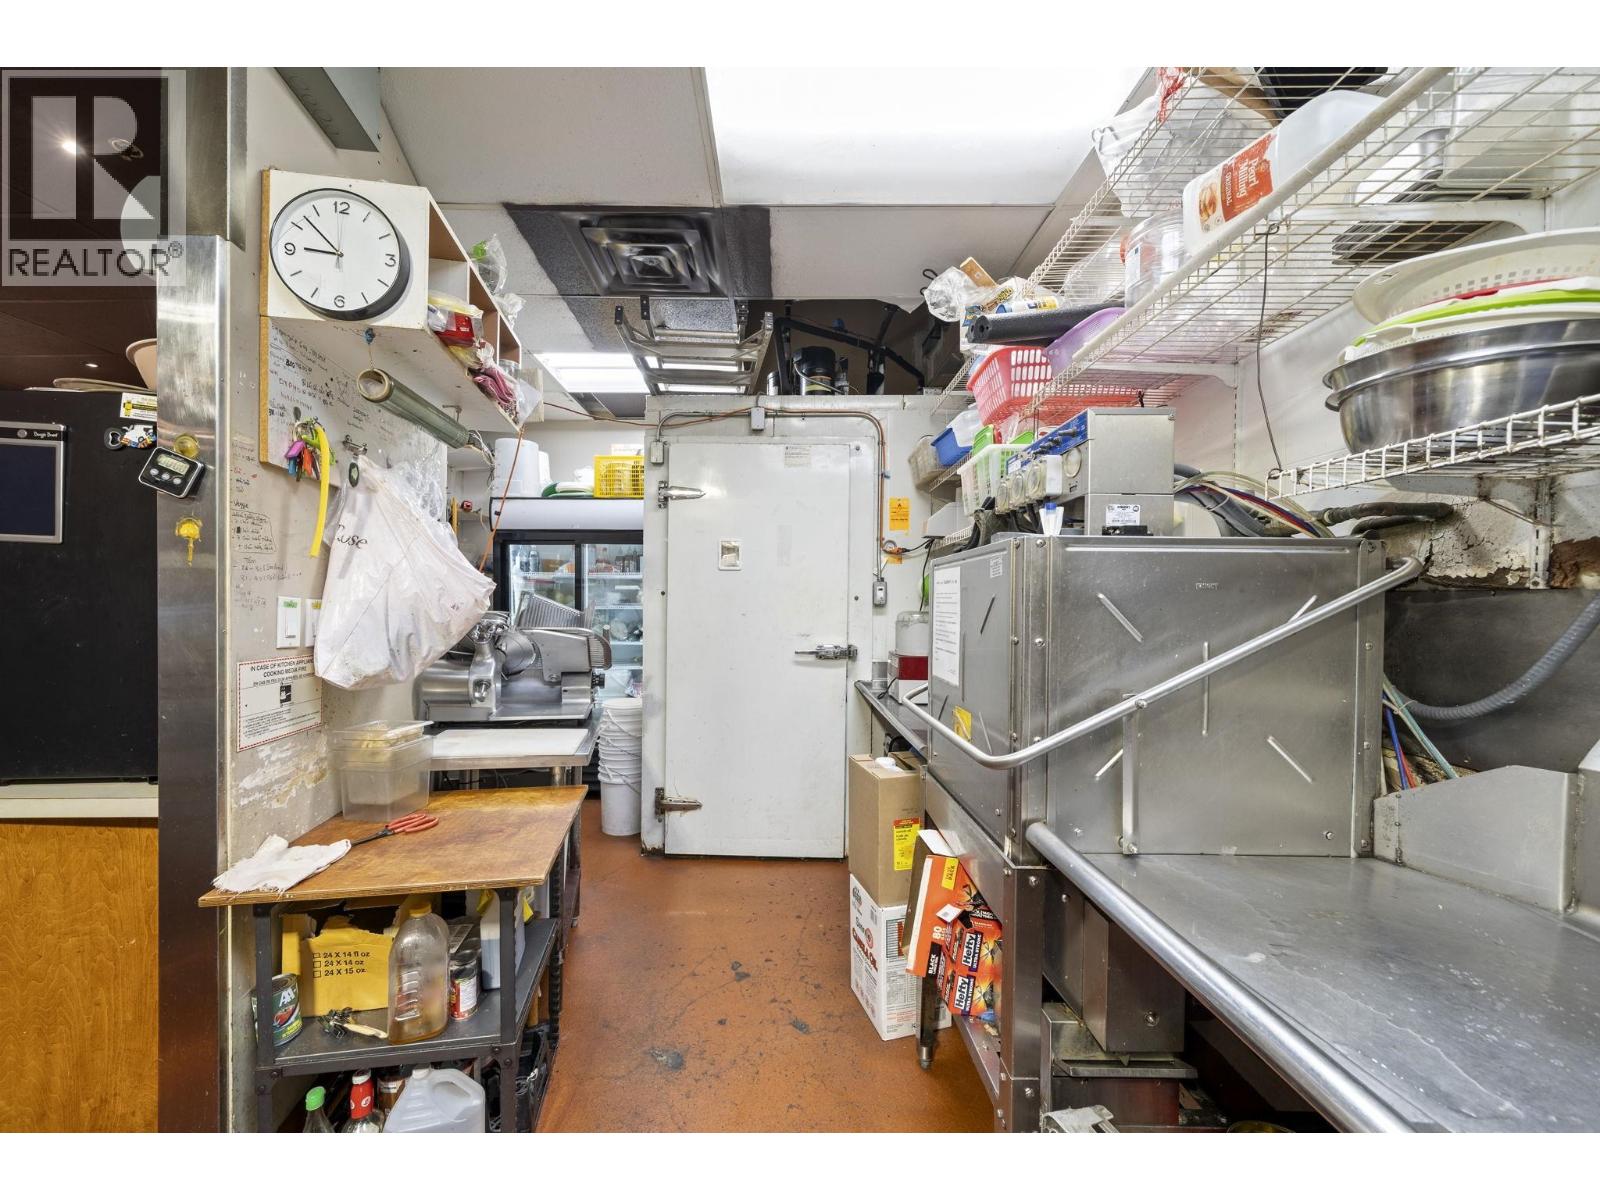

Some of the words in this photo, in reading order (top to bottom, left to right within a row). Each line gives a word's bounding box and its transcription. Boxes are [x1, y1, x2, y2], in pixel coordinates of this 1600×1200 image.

[1236, 159, 1249, 198] Milling
[1248, 157, 1259, 188] Pearl
[333, 201, 350, 215] 12
[284, 242, 296, 256] 9
[384, 253, 397, 267] 3
[333, 295, 345, 308] 6
[963, 934, 976, 965] Hefty
[928, 954, 936, 974] BLACK
[955, 978, 968, 1008] Hefty
